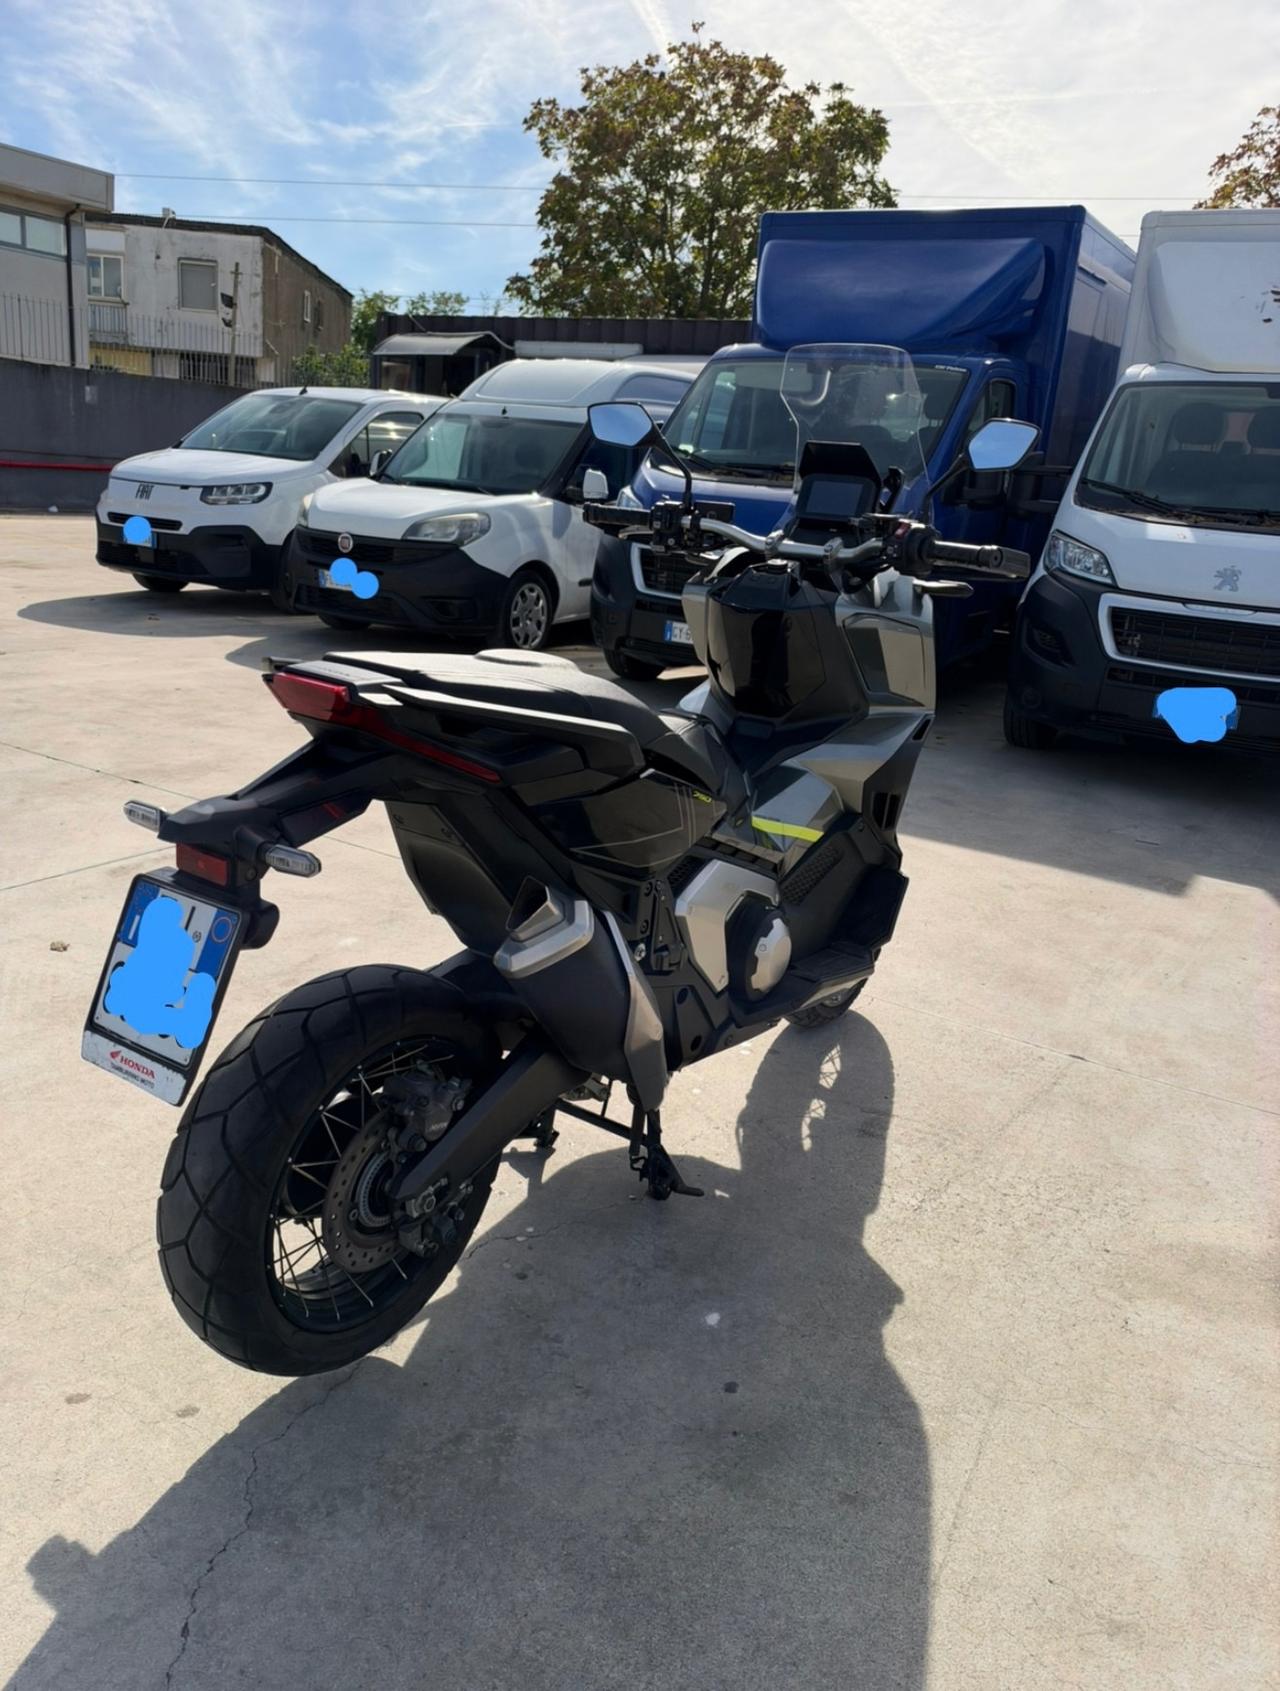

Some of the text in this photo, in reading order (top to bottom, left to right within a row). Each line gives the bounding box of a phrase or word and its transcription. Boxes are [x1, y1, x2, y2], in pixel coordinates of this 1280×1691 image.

[135, 483, 155, 500] FIAT
[692, 790, 712, 803] 750
[120, 1056, 155, 1079] HONDA
